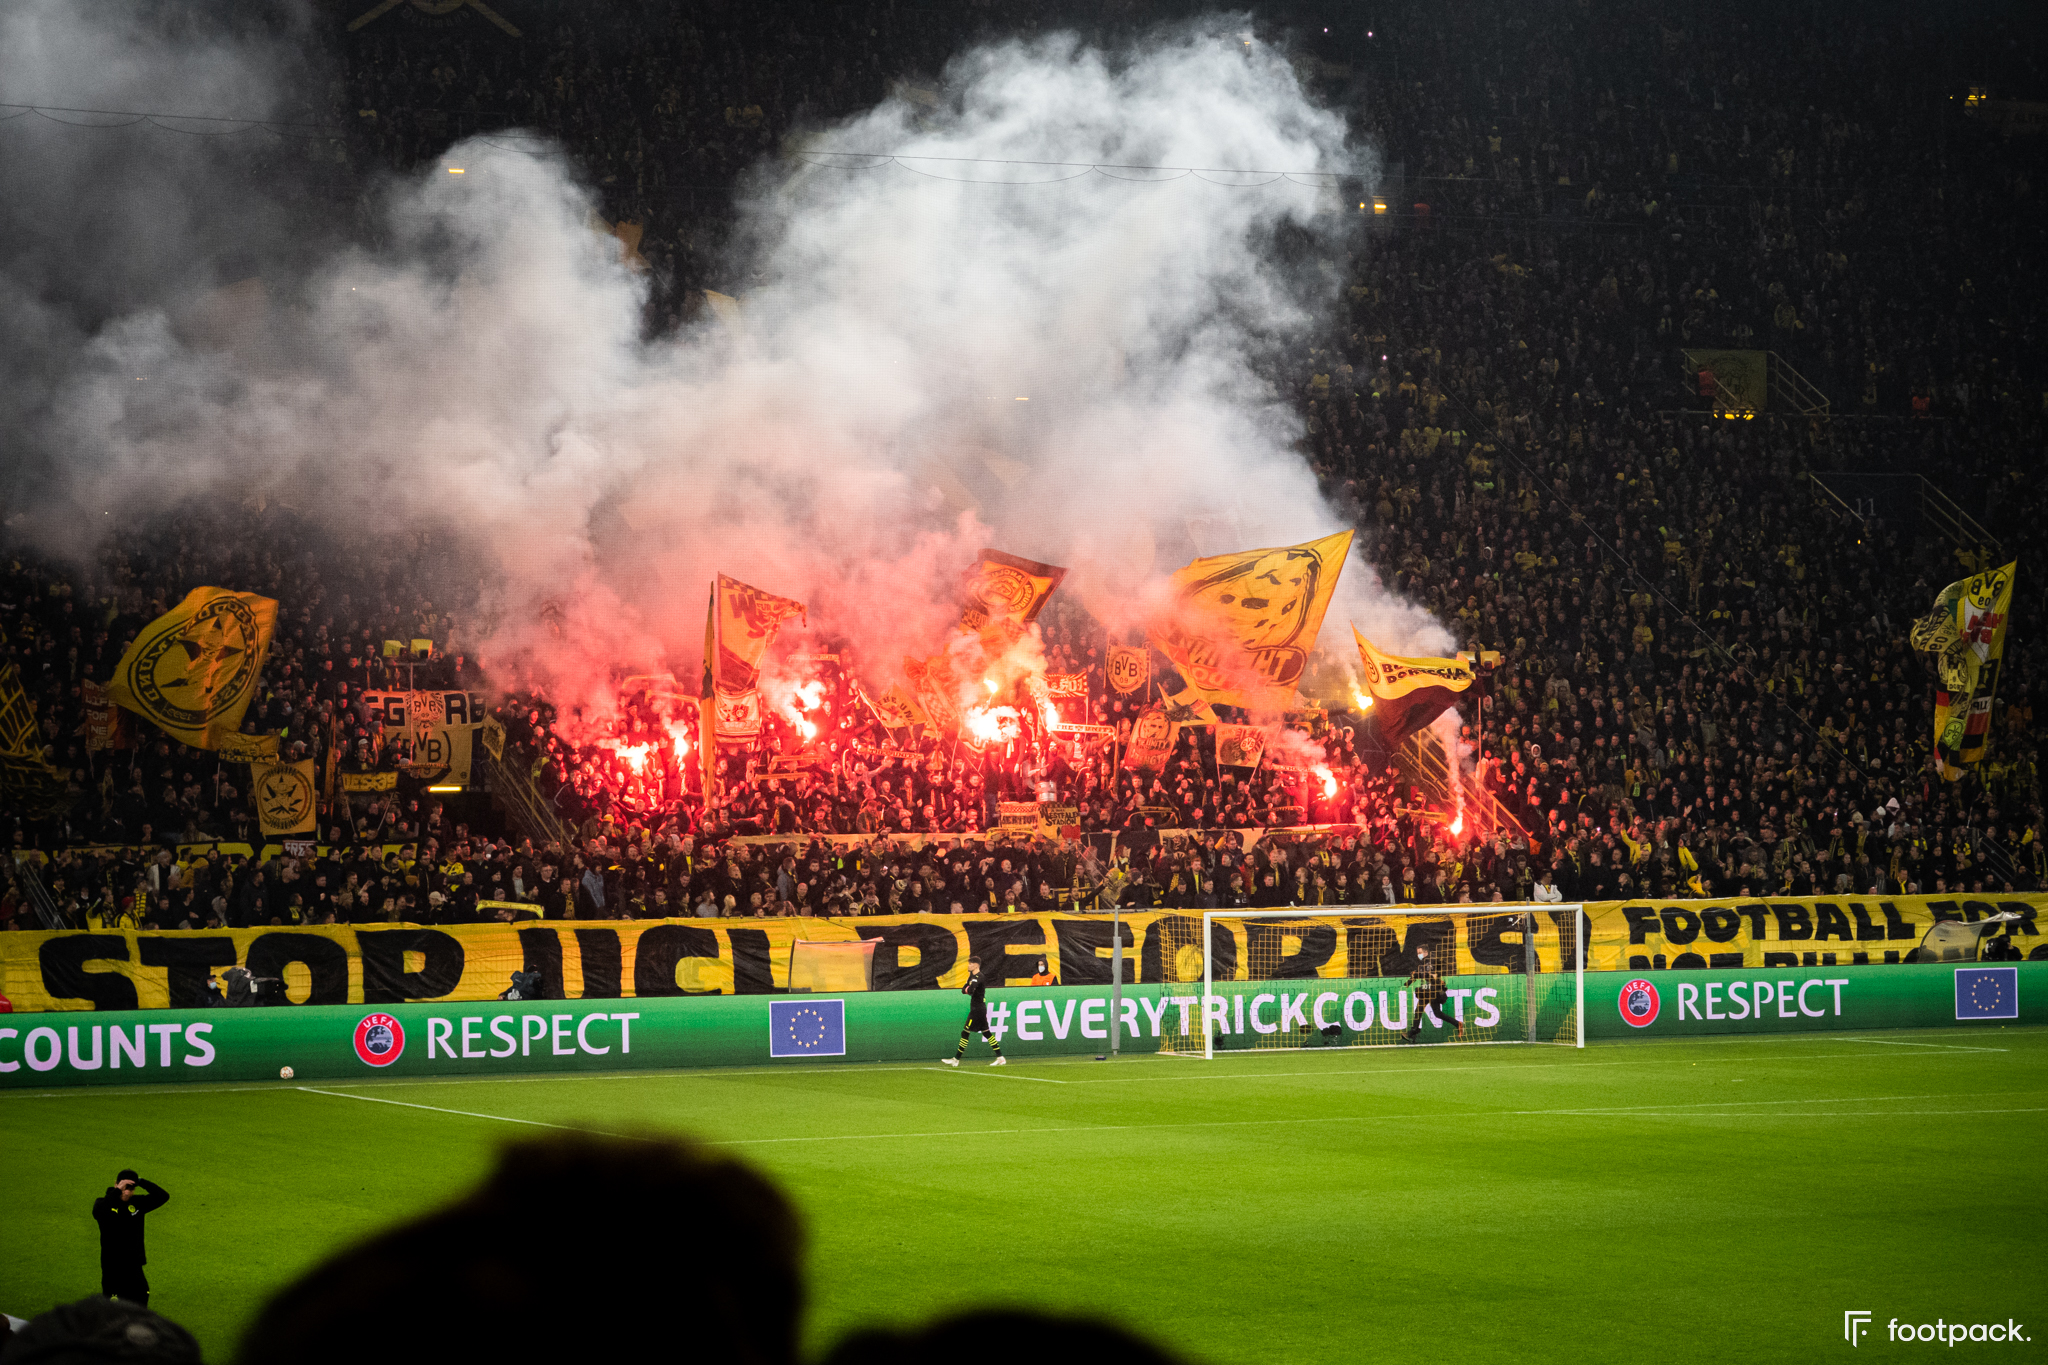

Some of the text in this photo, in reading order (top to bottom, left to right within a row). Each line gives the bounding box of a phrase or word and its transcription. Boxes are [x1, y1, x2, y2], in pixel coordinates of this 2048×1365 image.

[1114, 656, 1138, 678] BVB
[91, 724, 107, 736] NE
[1621, 902, 1915, 945] FOOTBALL
[38, 929, 466, 1010] STOP
[1626, 982, 1651, 993] UEFA
[363, 1016, 393, 1028] UEFA
[428, 1013, 640, 1059] RESPECT
[1678, 979, 1850, 1021] RESPECT
